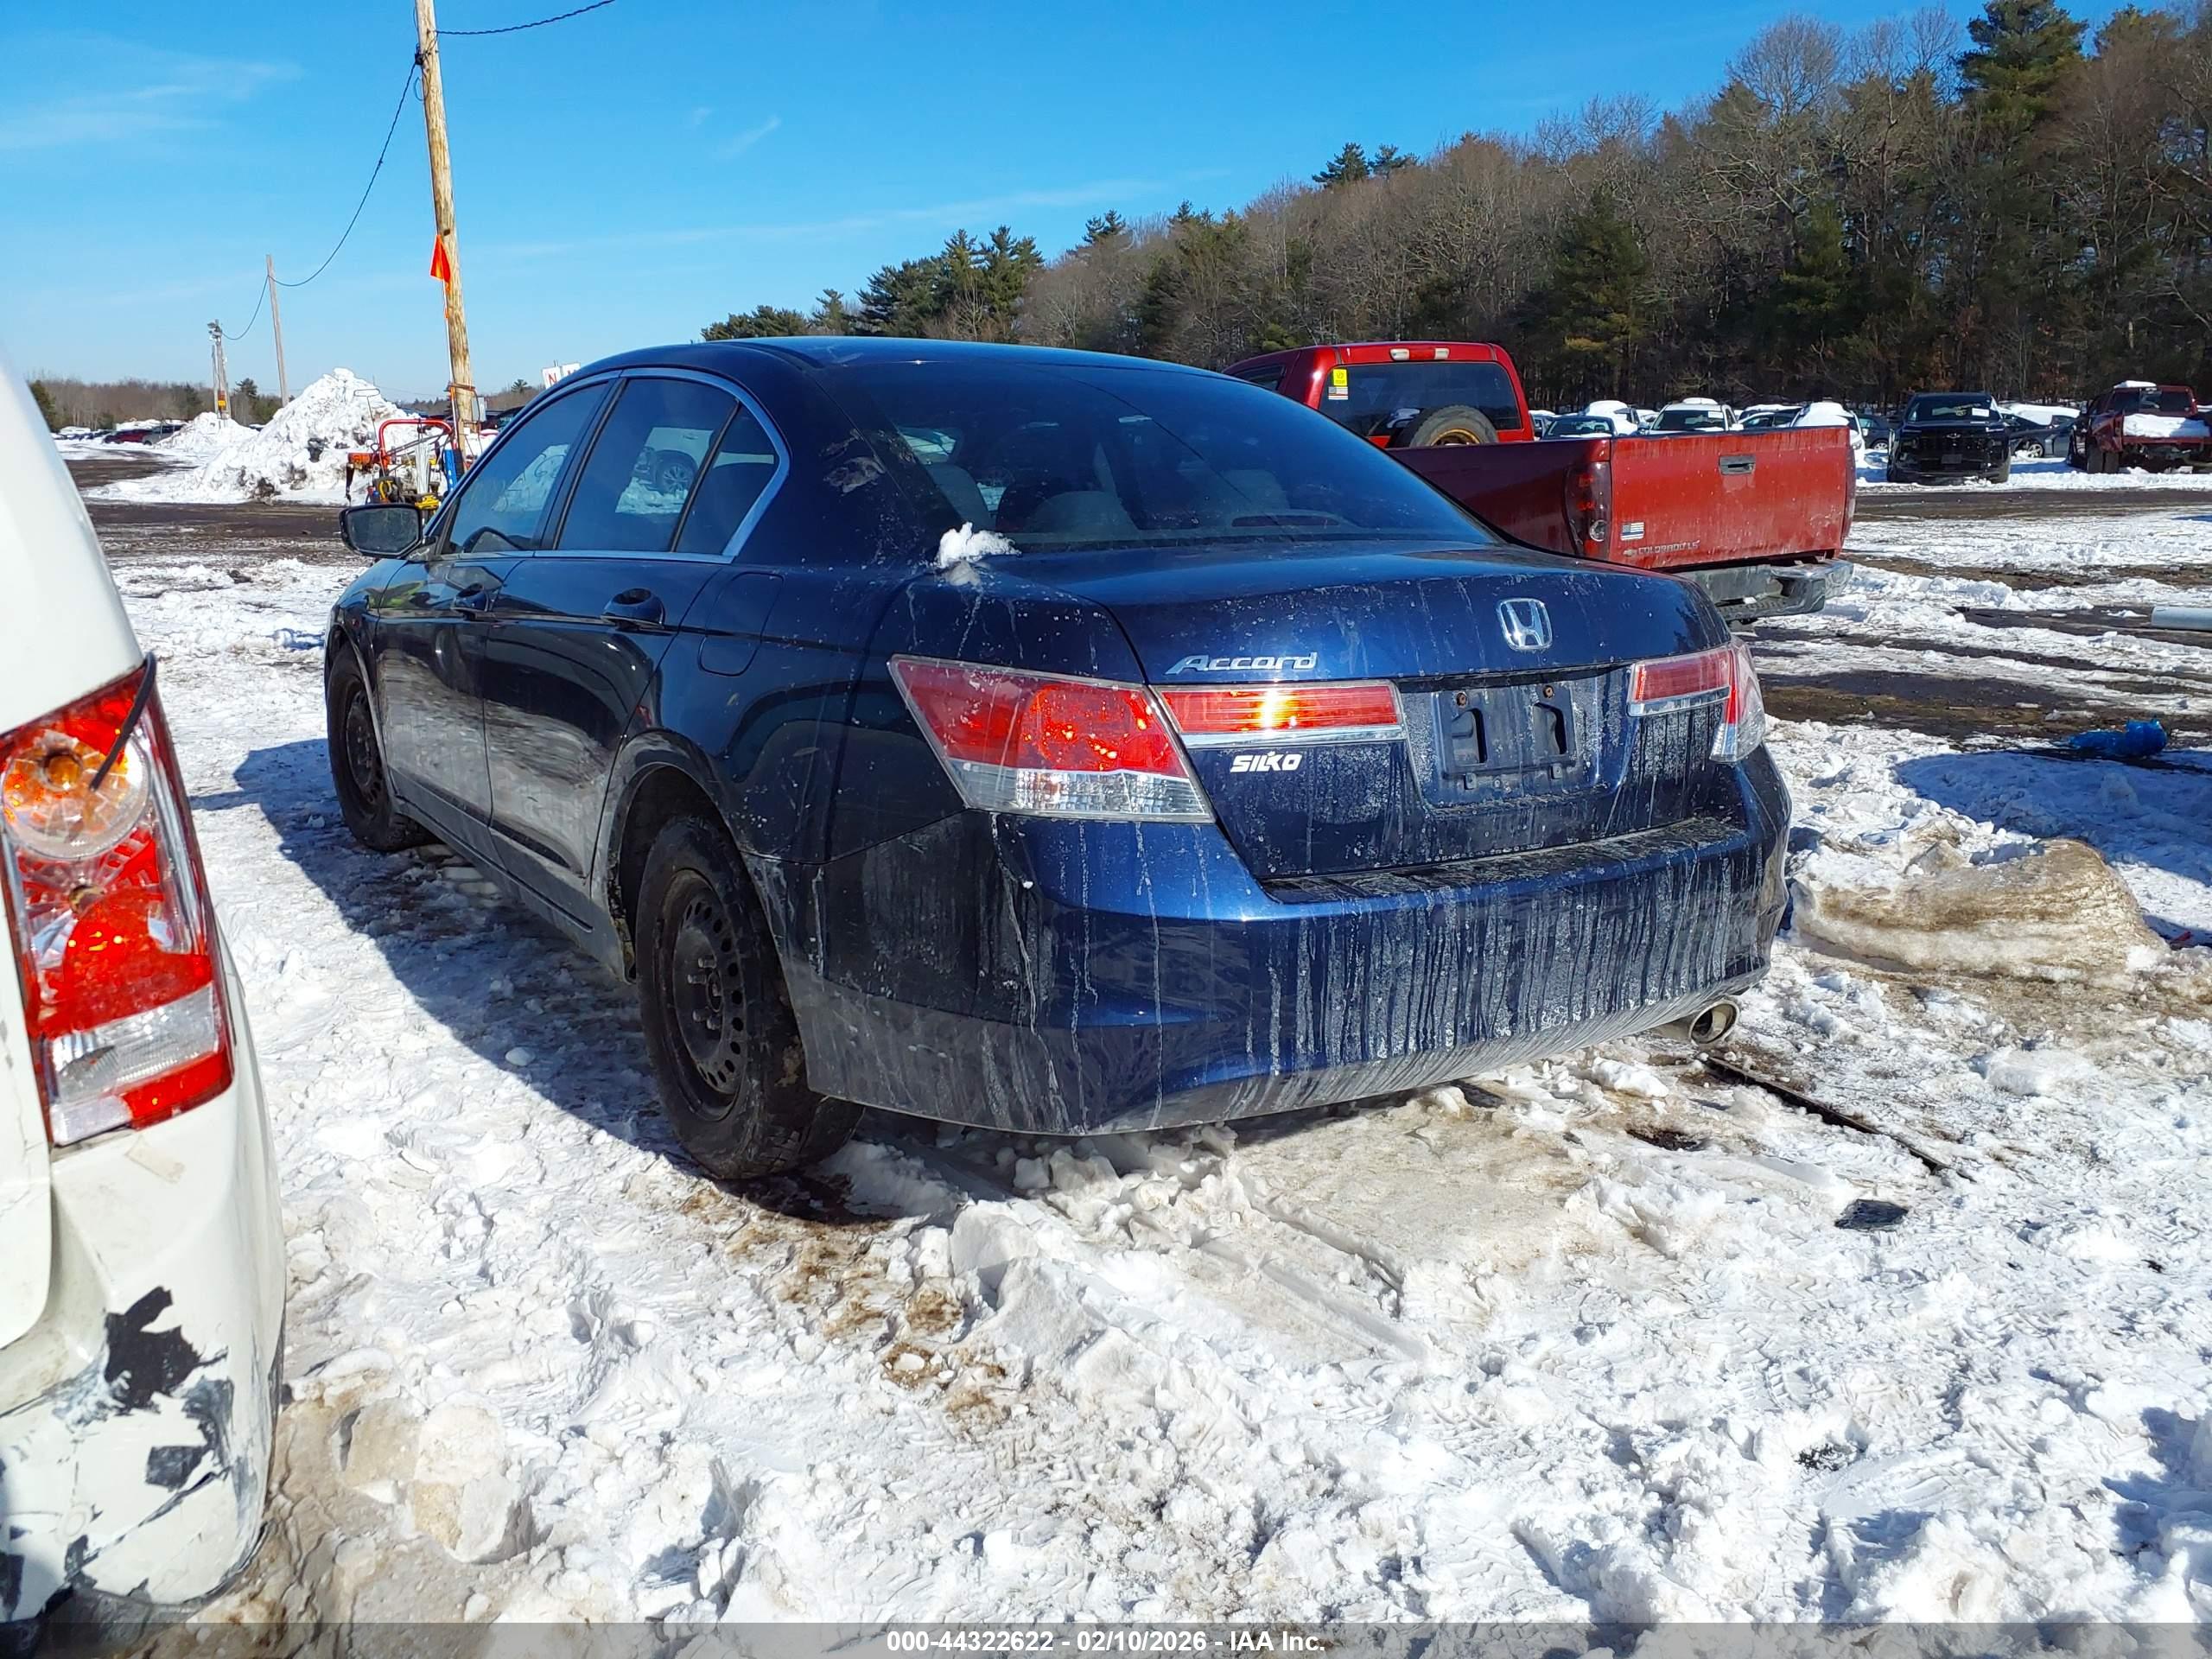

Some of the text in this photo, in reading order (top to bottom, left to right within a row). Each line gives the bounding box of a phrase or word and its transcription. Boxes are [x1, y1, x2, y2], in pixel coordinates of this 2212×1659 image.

[1638, 543, 1686, 555] COLORADO
[1164, 652, 1318, 675] Accord
[1230, 751, 1302, 772] SILKO
